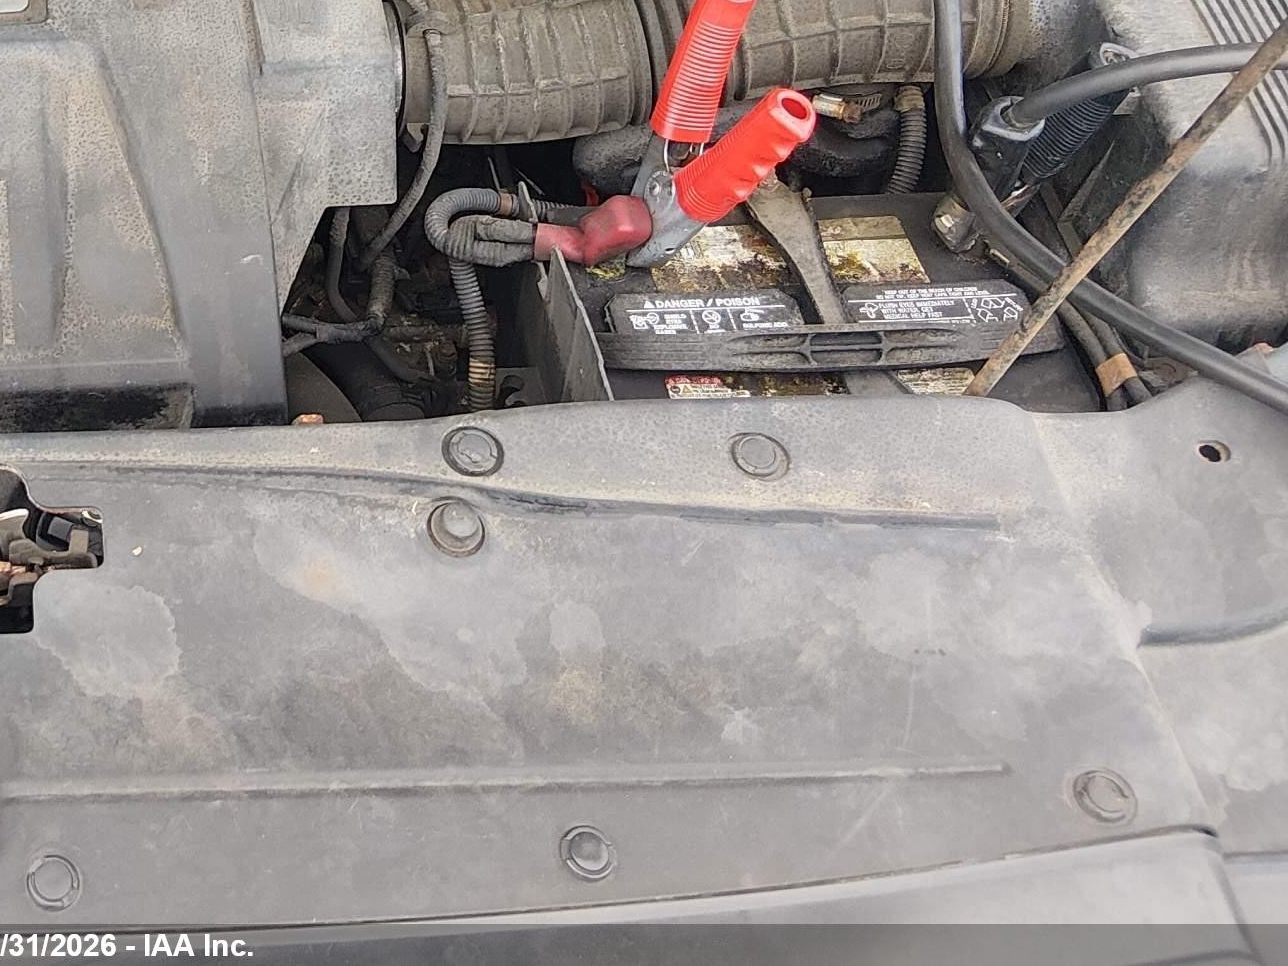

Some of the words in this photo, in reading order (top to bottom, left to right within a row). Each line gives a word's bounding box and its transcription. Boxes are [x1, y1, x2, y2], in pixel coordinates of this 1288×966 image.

[655, 300, 705, 308] DANGER
[706, 298, 713, 307] /
[715, 297, 762, 306] POISON
